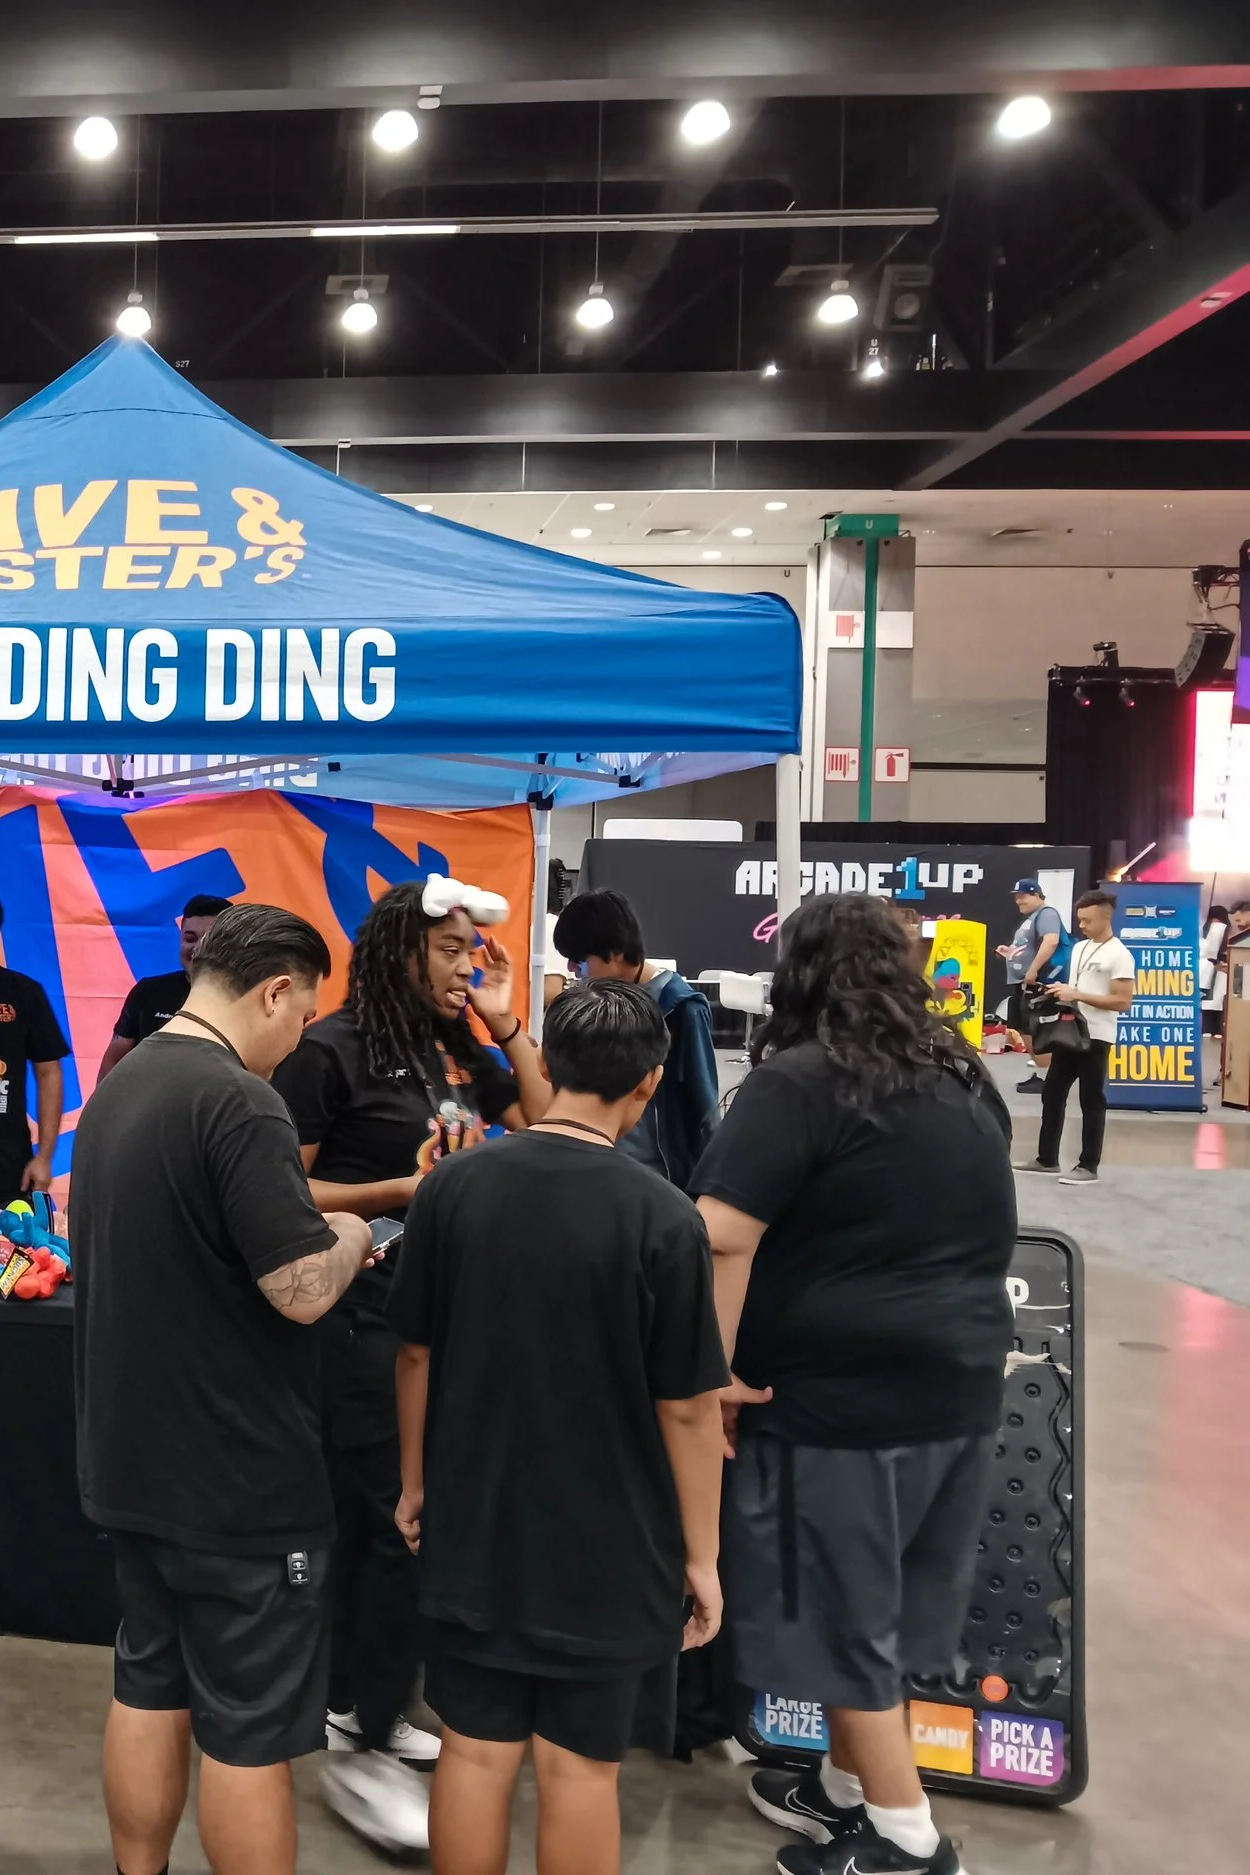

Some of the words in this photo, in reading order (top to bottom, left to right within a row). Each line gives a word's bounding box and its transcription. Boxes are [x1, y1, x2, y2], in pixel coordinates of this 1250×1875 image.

[231, 487, 306, 546] &
[865, 519, 874, 529] U
[204, 627, 397, 722] DING
[1142, 950, 1194, 967] HOME
[1131, 1004, 1141, 1018] IT
[1142, 1004, 1155, 1018] IN
[1156, 1005, 1194, 1019] ACTION
[1118, 1026, 1151, 1042] AKE
[1162, 1027, 1194, 1043] ONE
[1108, 1044, 1195, 1082] HOME
[765, 1709, 823, 1740] PRIZE
[913, 1723, 970, 1749] CANDY
[990, 1719, 1035, 1747] PICK
[1040, 1726, 1054, 1750] A
[990, 1742, 1054, 1778] PRIZE
